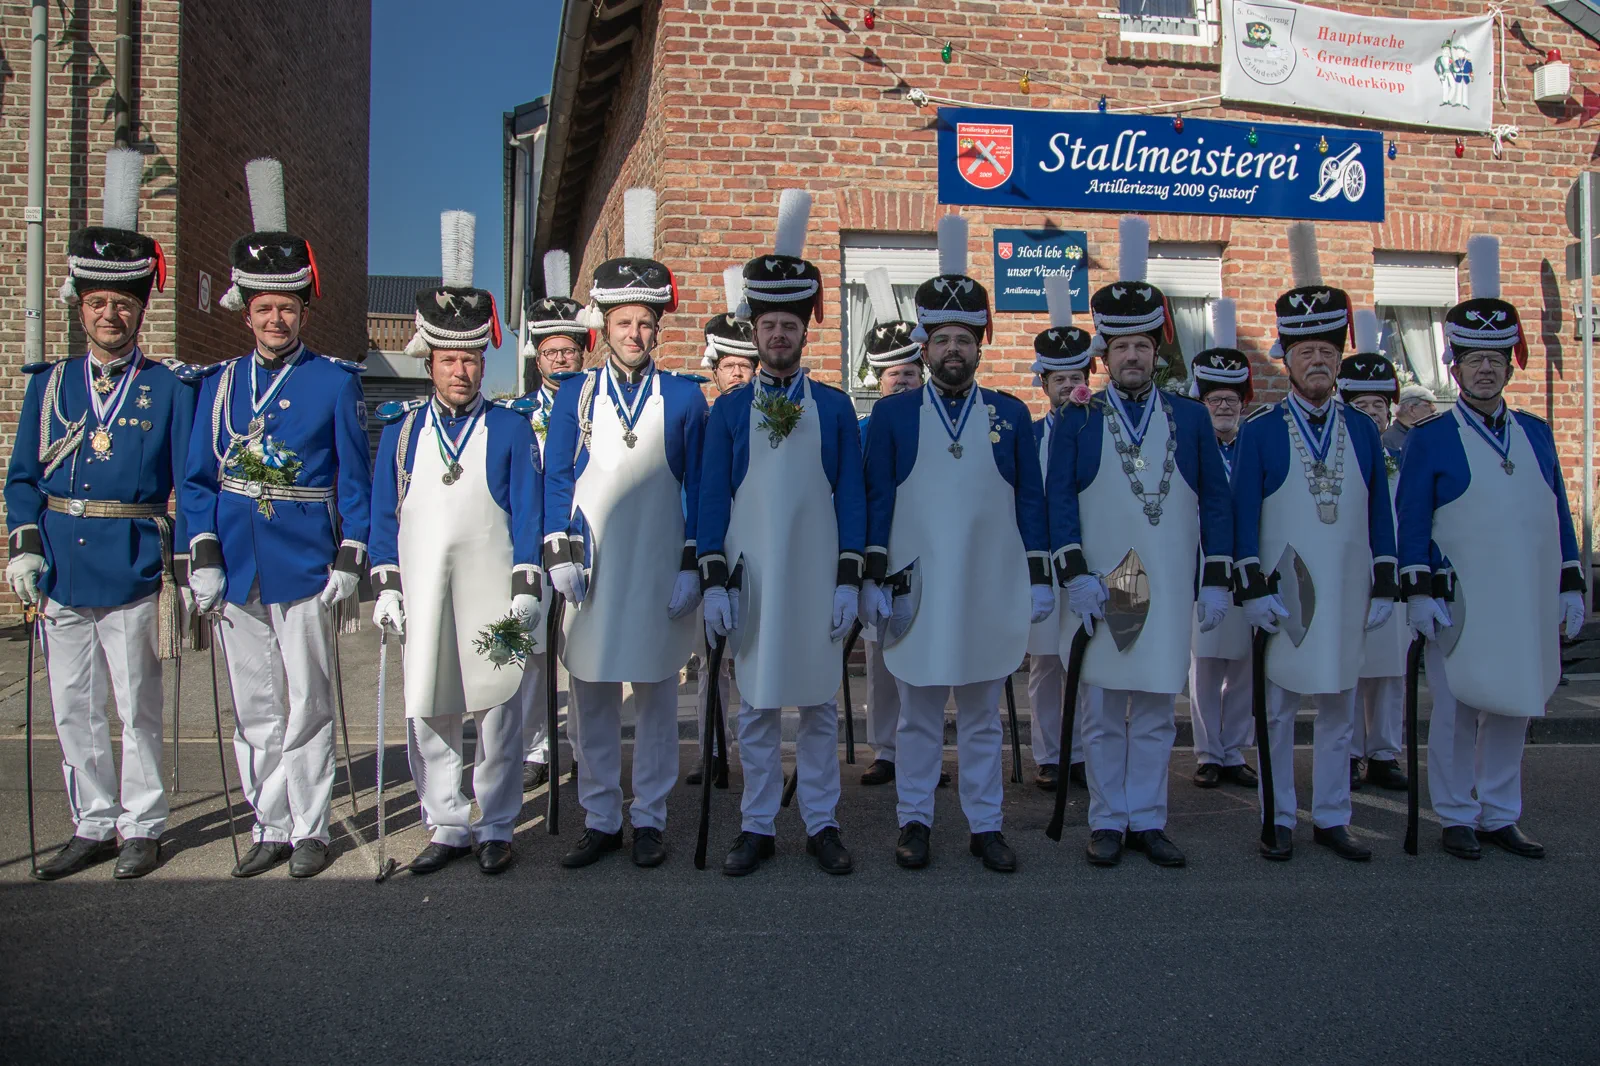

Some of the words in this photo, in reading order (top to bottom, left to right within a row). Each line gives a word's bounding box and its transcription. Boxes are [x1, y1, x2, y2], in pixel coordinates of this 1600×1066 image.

[1317, 26, 1405, 49] Hauptwache
[1317, 50, 1413, 74] Grenadierzug
[1315, 66, 1405, 94] Zylinderköpp
[961, 127, 990, 135] Artilleriezug
[1038, 129, 1301, 181] Stallmeisterei
[1085, 178, 1170, 200] Artilleriezug
[1173, 183, 1205, 197] 2009
[1208, 184, 1259, 204] Gustorf
[1017, 245, 1042, 258] Hoch
[1044, 245, 1062, 258] lebe
[1007, 267, 1033, 277] unser
[1034, 264, 1076, 281] Vizechef
[1003, 286, 1041, 297] Artilleriezug
